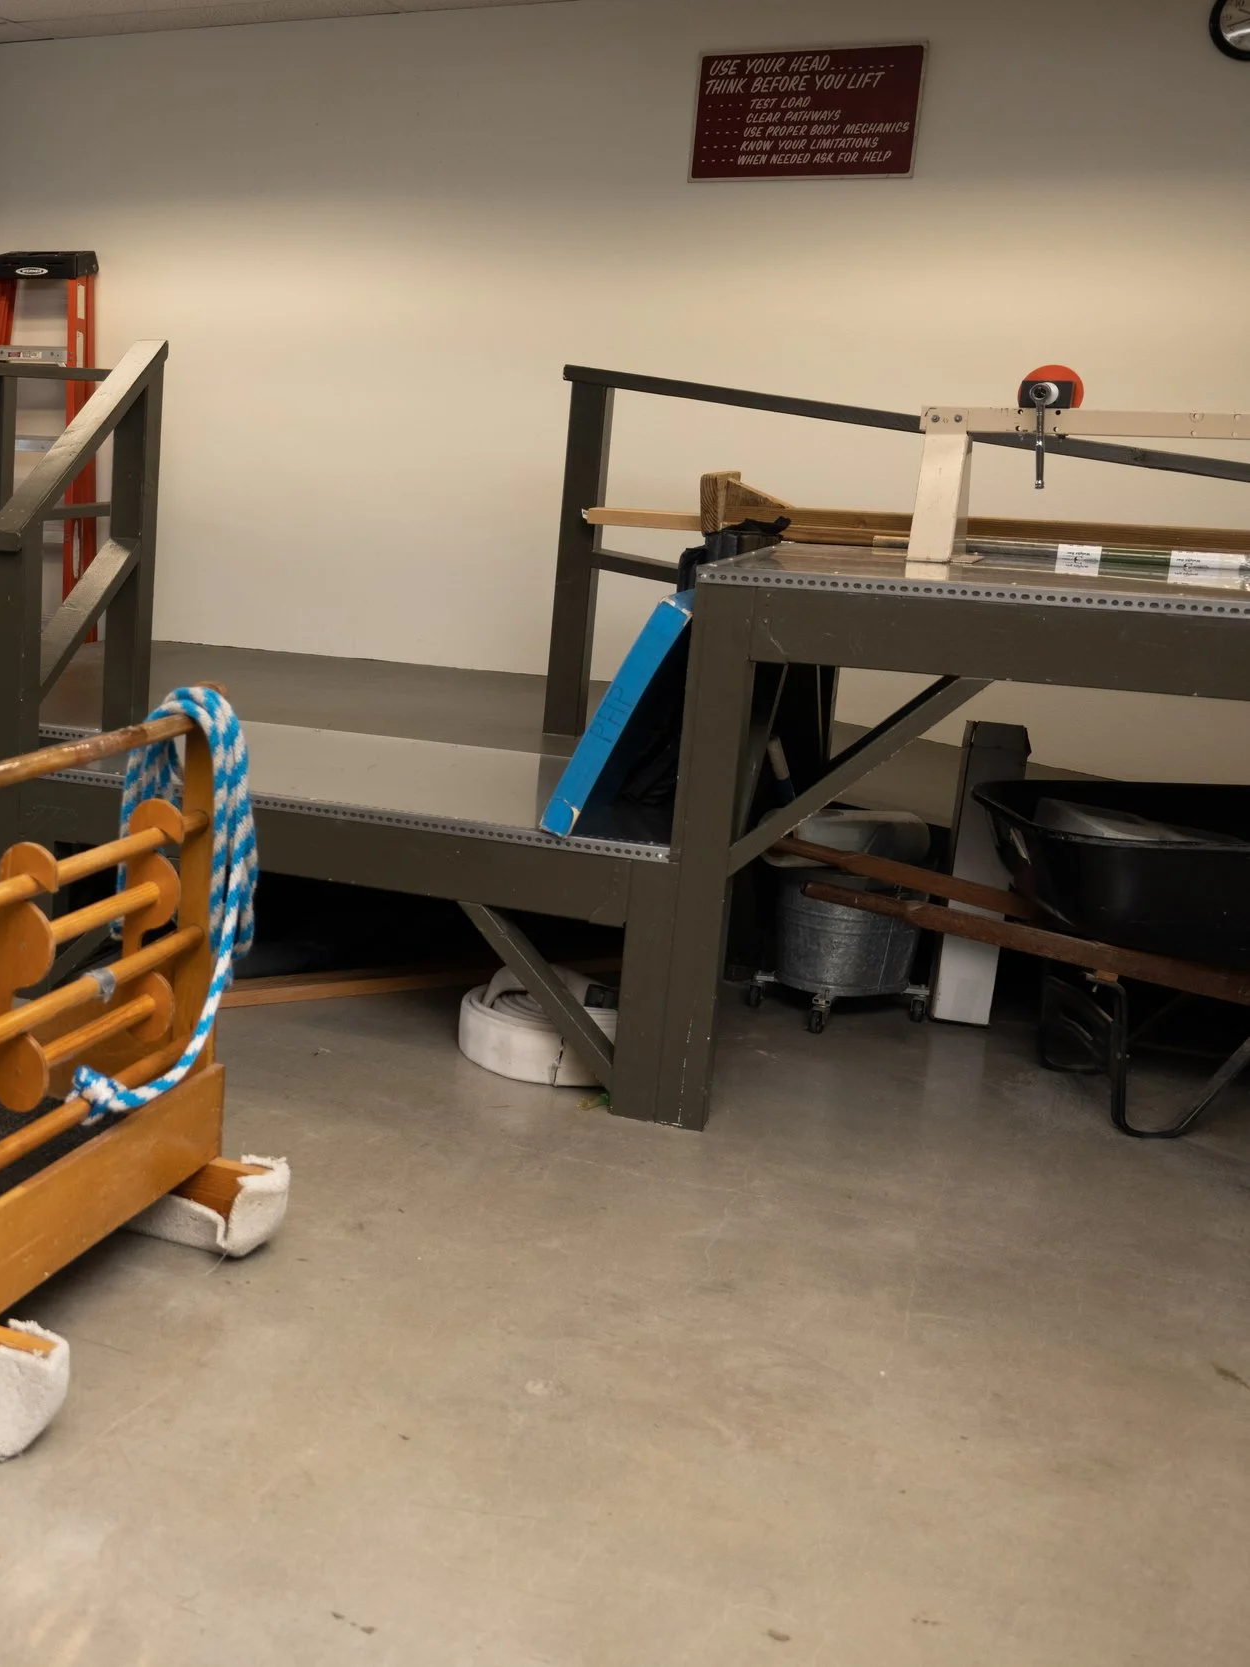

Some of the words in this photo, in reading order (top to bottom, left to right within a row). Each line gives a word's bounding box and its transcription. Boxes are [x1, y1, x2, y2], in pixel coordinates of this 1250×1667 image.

[709, 60, 741, 76] USE
[745, 57, 786, 75] YOUR
[705, 78, 747, 95] THINK
[750, 75, 810, 93] BEFORE
[815, 73, 847, 90] YOU
[847, 71, 885, 89] LIFT
[750, 98, 778, 110] TEST
[780, 96, 811, 108] LOAD
[746, 111, 781, 123] CLEAR
[784, 109, 841, 122] PATHWAYS
[743, 127, 764, 137] USE
[765, 125, 808, 137] PROPER
[810, 124, 840, 135] BODY
[843, 121, 910, 134] MECHANICS
[740, 140, 774, 151] KNOW
[778, 139, 808, 150] YOUR
[810, 136, 879, 149] LIMITATIONS
[737, 154, 768, 165] WHEN
[770, 153, 810, 164] NEEDED
[812, 152, 834, 164] ASK
[836, 151, 859, 163] FOR
[862, 150, 892, 162] HELP
[589, 686, 634, 743] PHP
